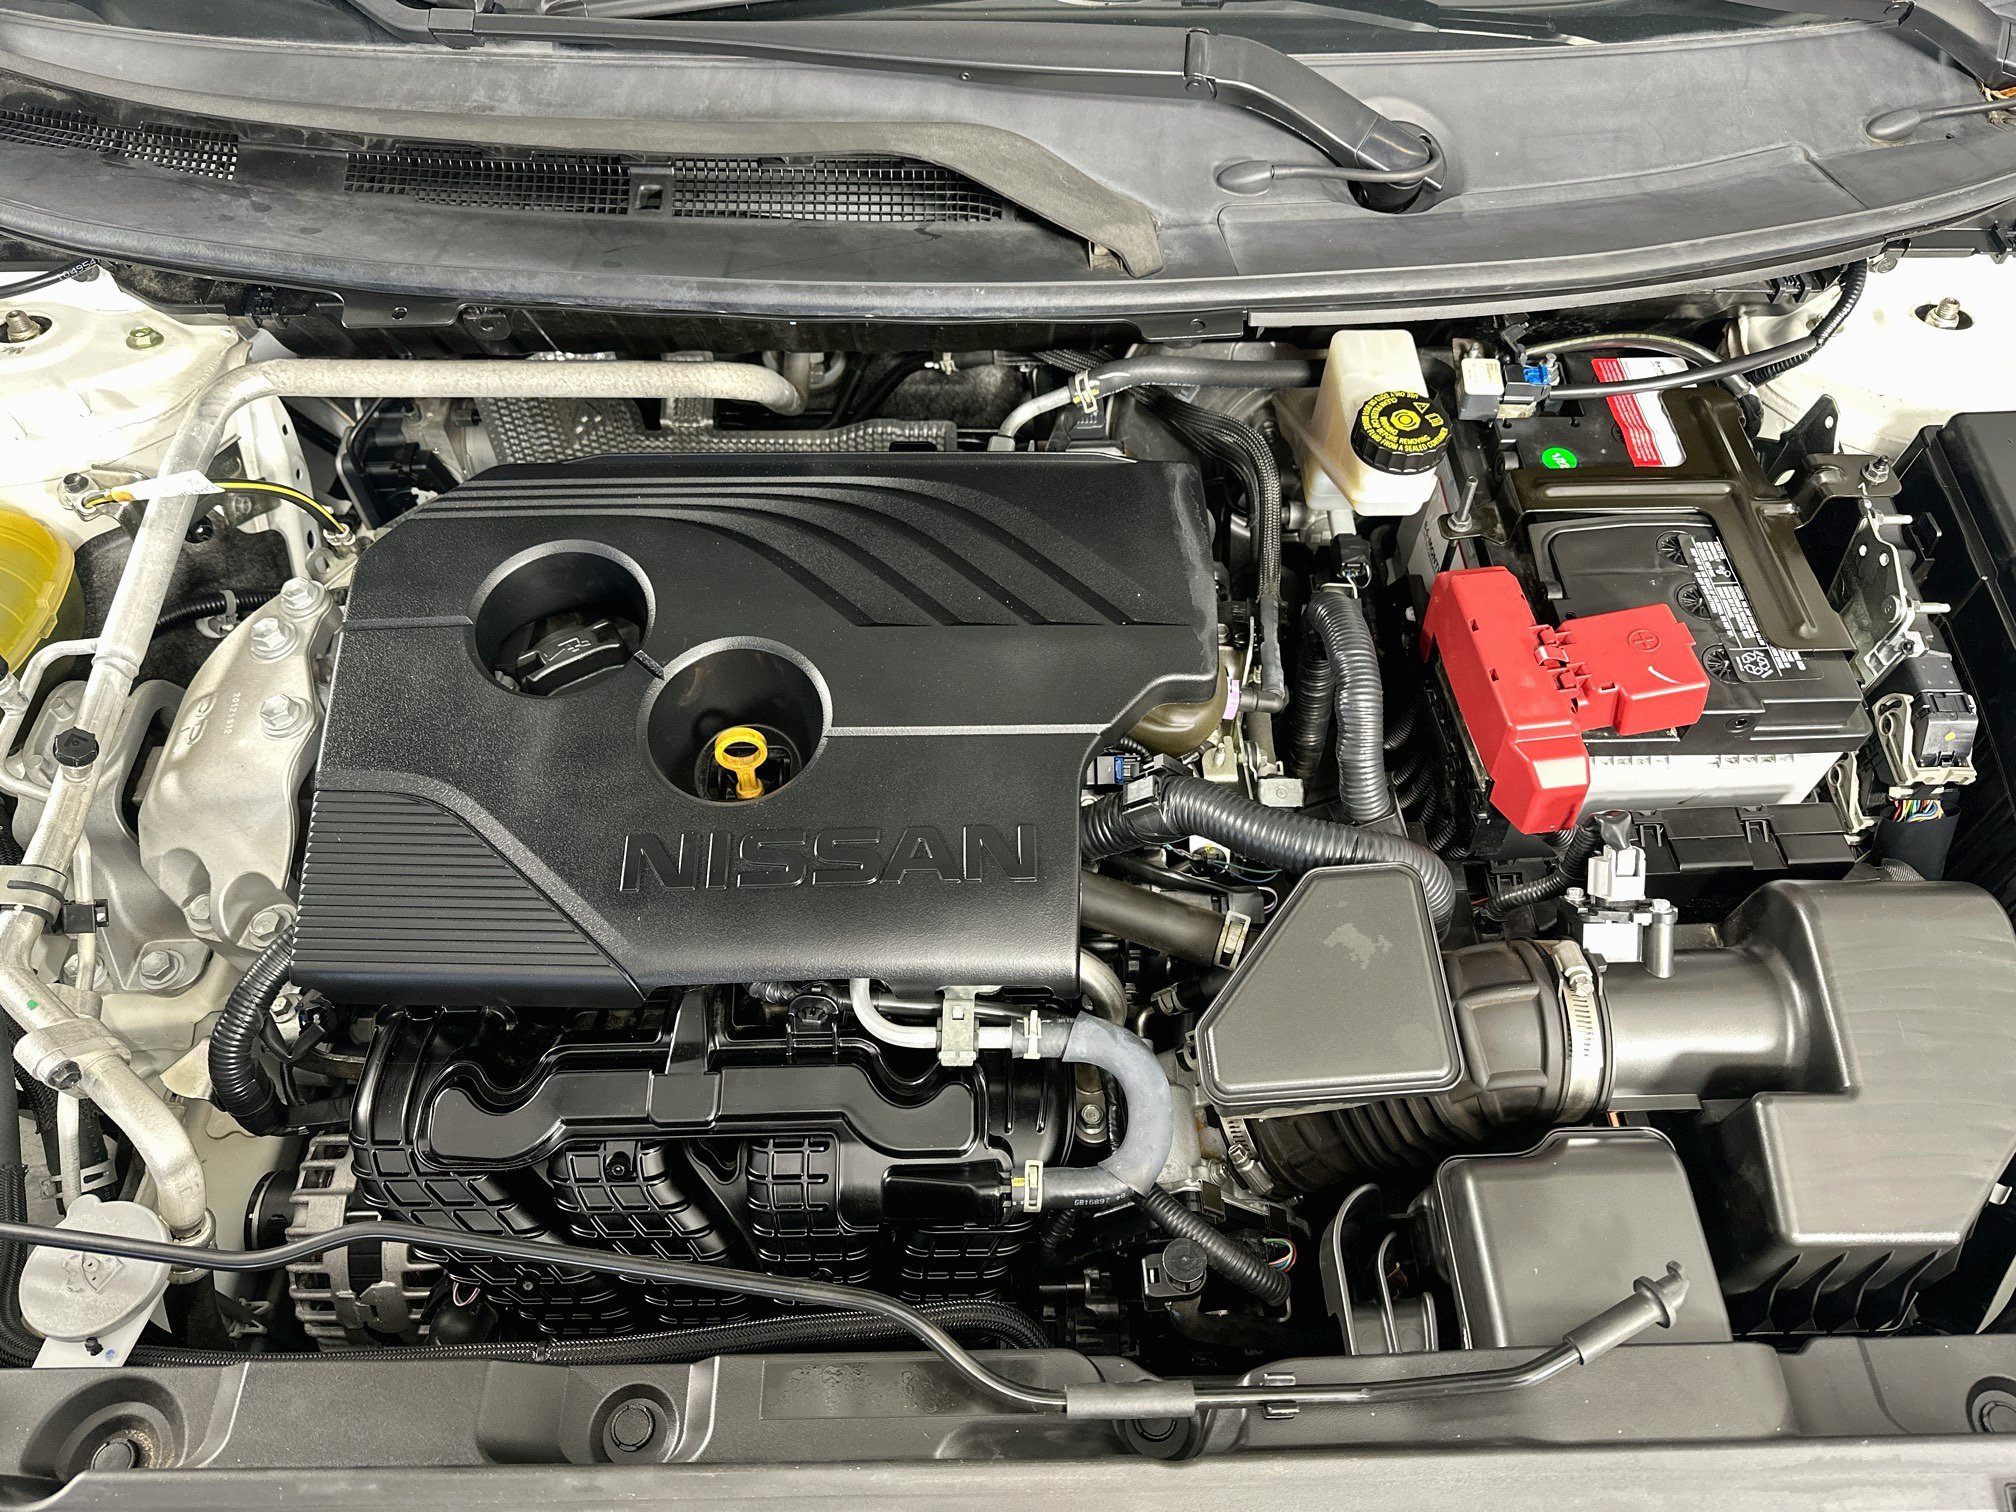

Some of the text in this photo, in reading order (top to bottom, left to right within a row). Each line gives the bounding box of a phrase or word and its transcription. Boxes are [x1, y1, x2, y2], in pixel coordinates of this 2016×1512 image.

[1376, 428, 1399, 443] BEFORE
[1399, 435, 1431, 445] REMOVING
[1380, 439, 1399, 450] FROM
[1404, 443, 1428, 453] SEALED
[618, 824, 1038, 892] NISSAN
